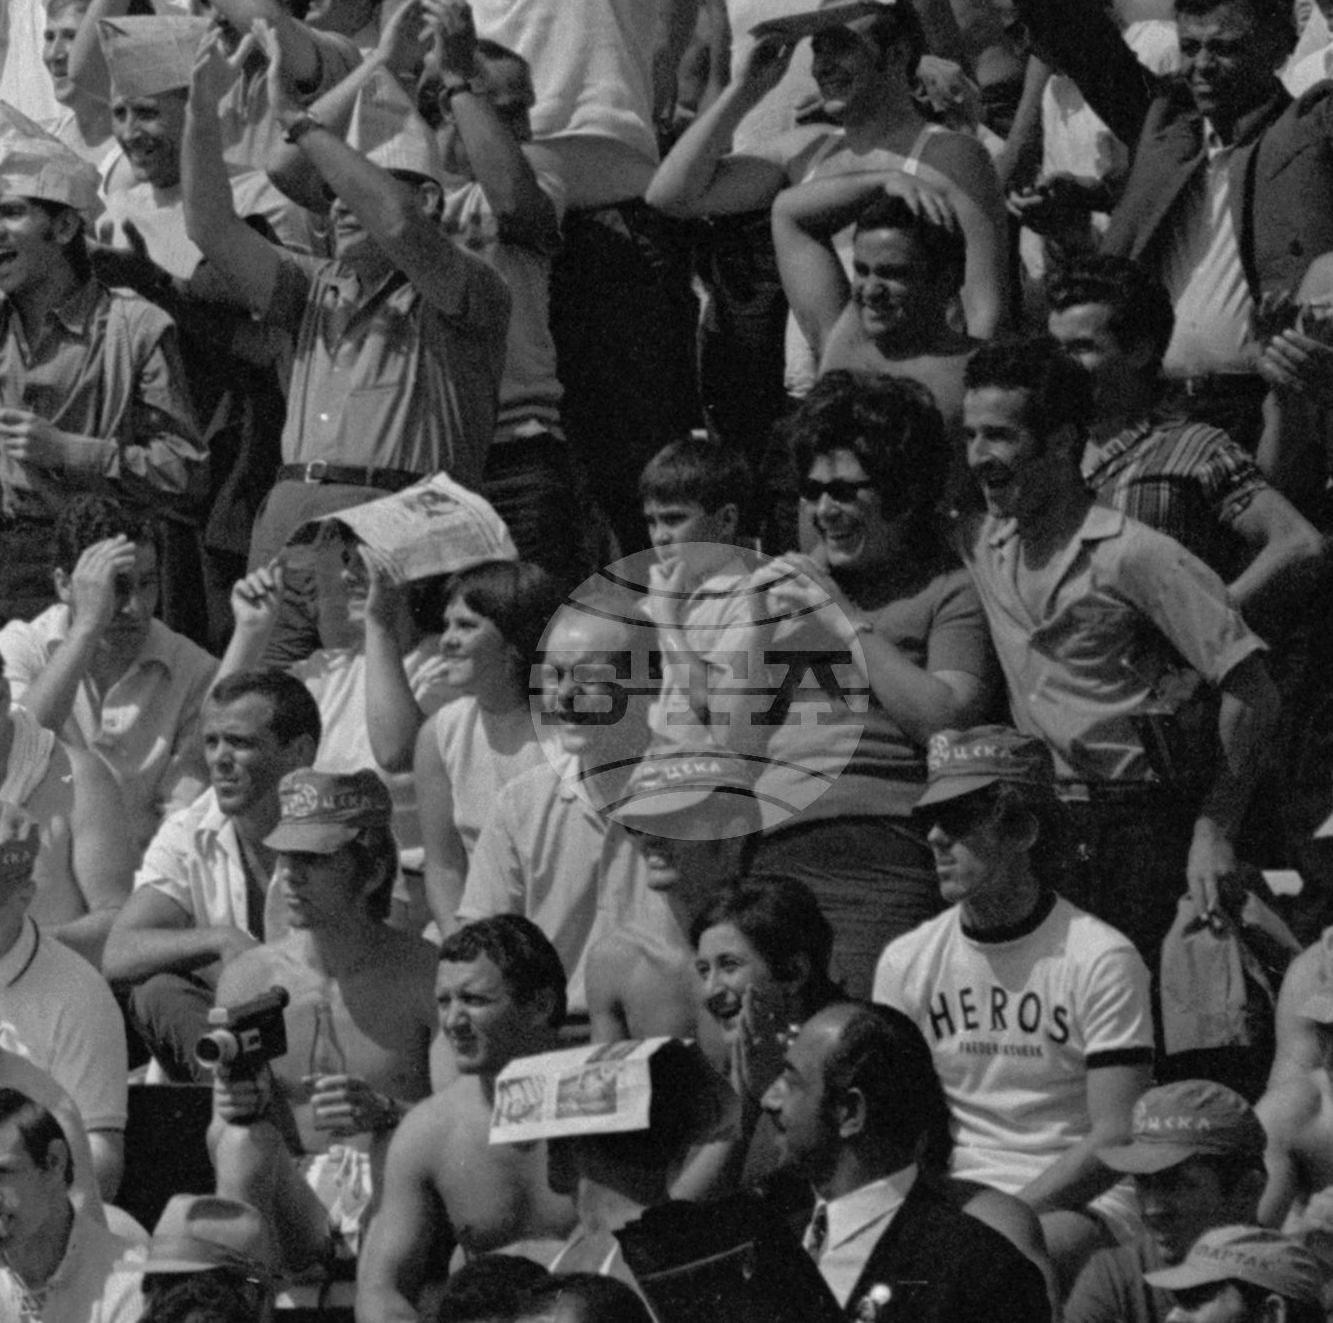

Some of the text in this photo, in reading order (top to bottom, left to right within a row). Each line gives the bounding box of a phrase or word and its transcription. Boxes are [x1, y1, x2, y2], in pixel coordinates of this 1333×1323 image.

[952, 745, 1014, 760] ЦСКА
[664, 761, 722, 780] ЦСКА
[929, 985, 1070, 1045] HEROS
[1146, 1114, 1212, 1131] ЦСКА
